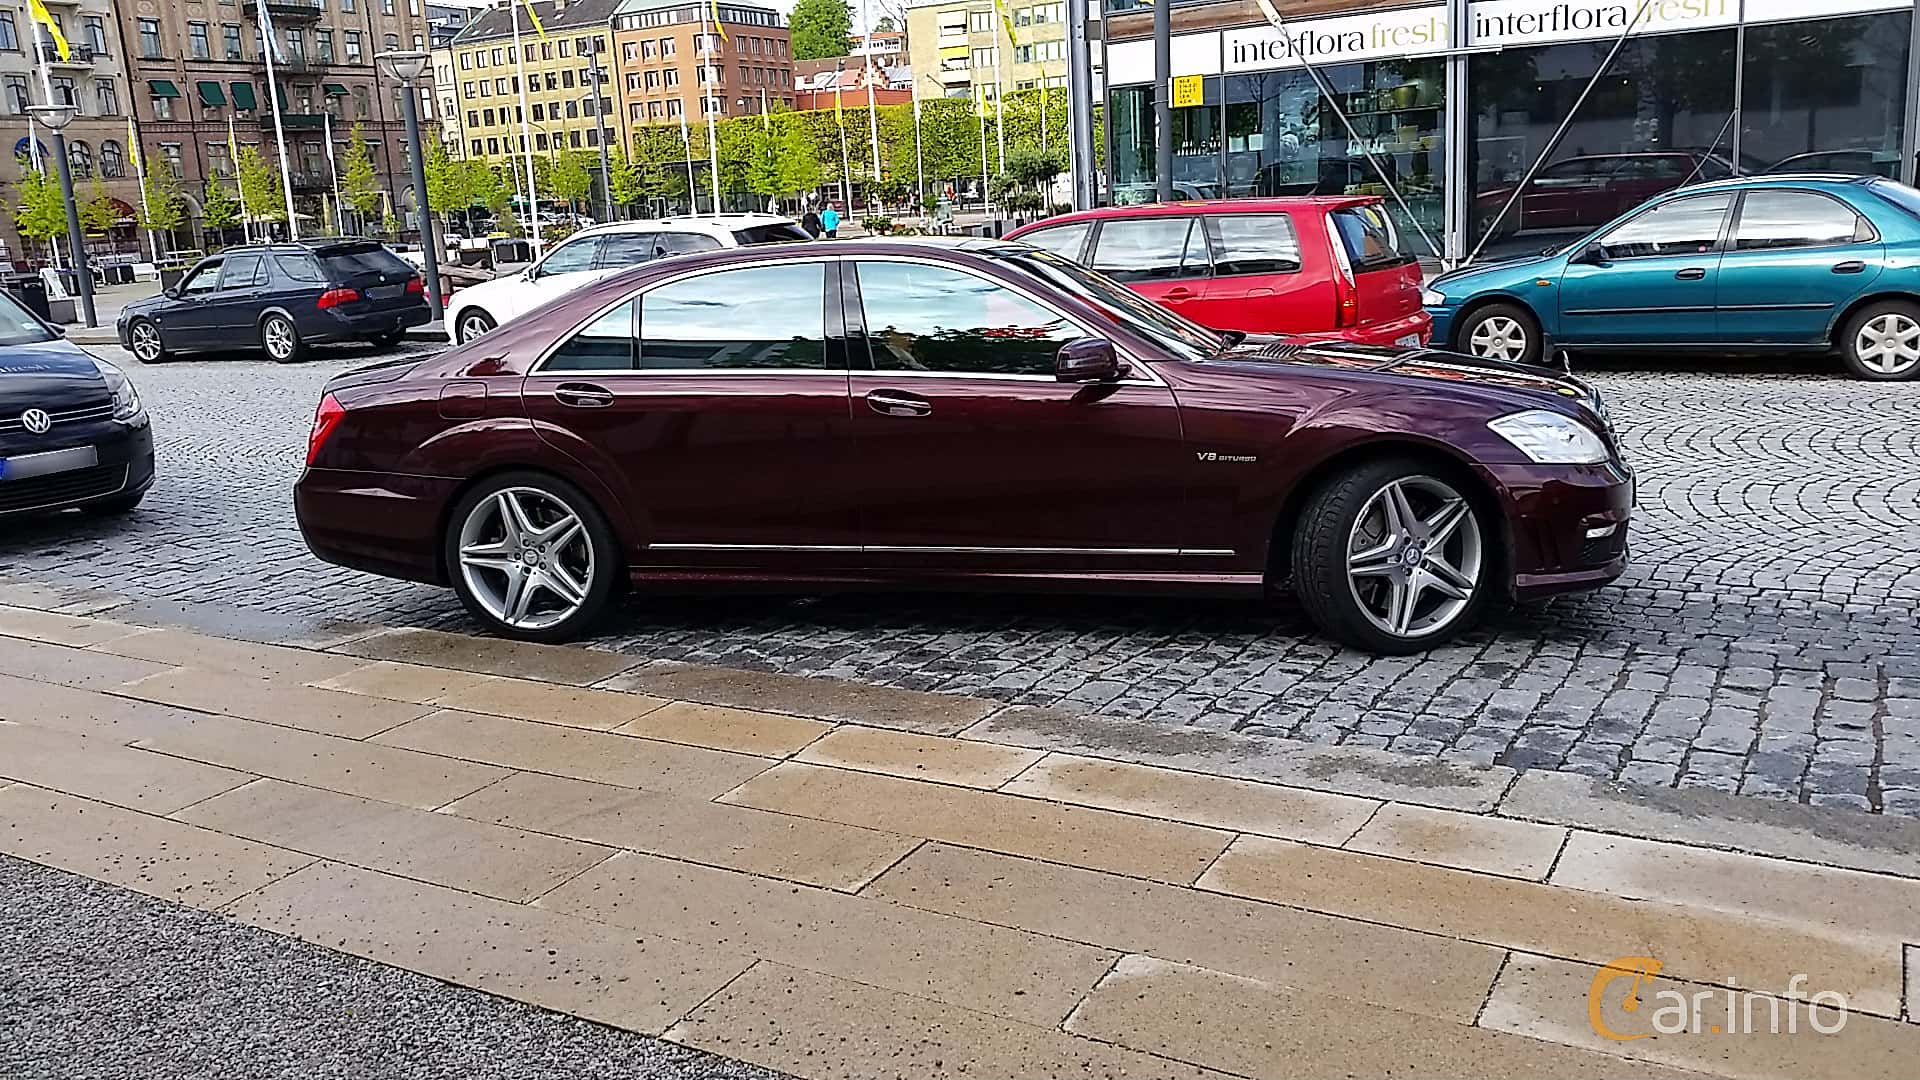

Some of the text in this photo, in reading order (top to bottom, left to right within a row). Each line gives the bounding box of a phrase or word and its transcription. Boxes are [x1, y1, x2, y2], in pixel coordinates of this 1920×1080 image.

[1475, 4, 1628, 38] interflora
[1233, 30, 1365, 63] interflora
[1196, 452, 1217, 461] V8
